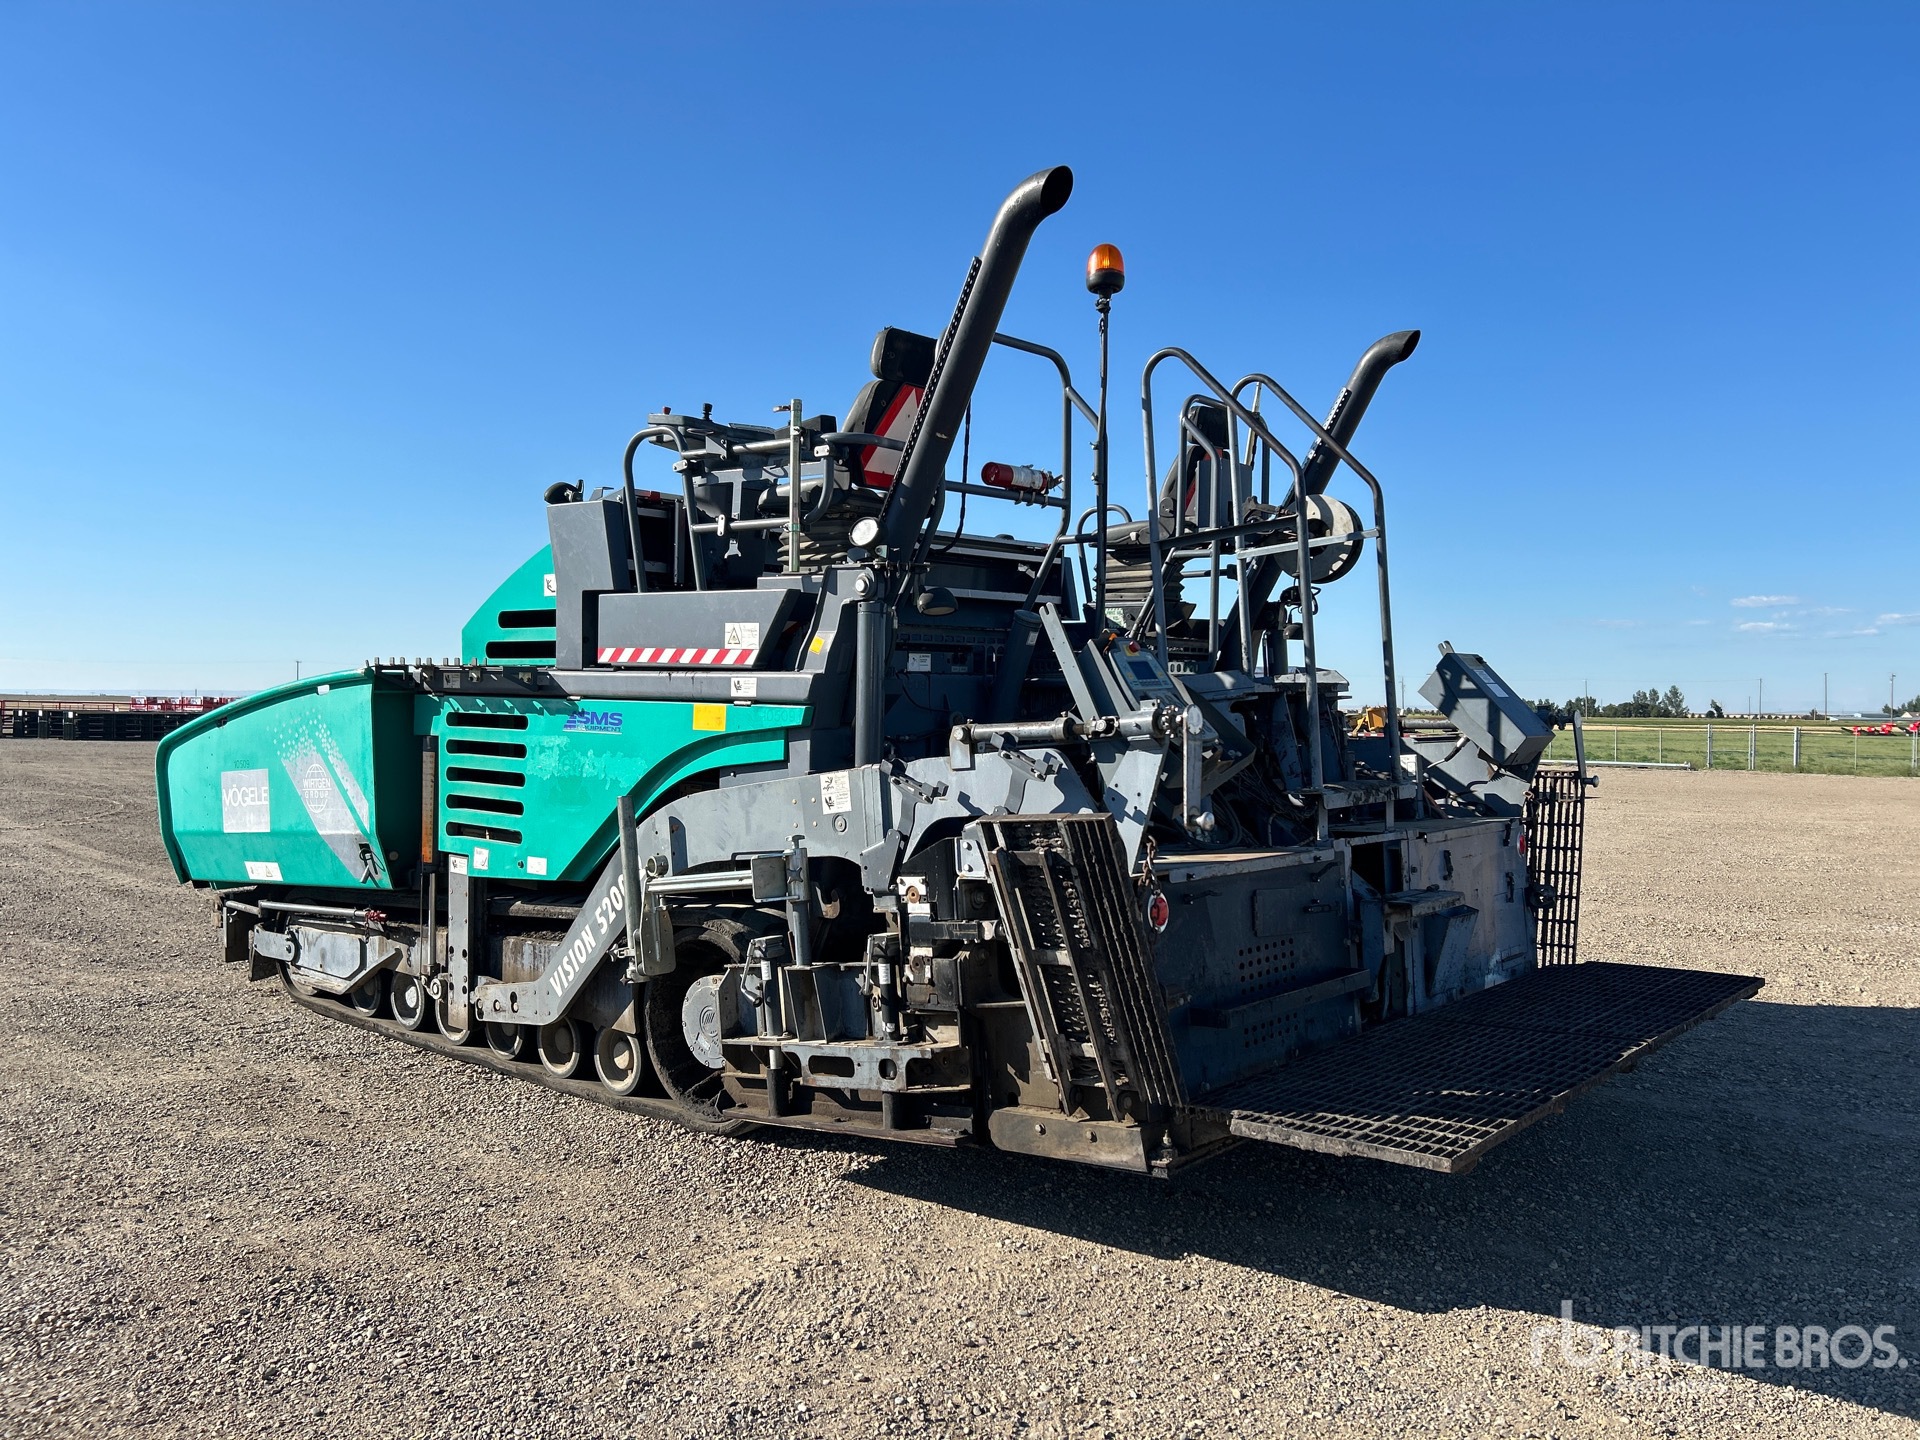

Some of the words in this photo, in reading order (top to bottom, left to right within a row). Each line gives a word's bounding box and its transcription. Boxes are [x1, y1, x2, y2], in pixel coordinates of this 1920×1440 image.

[577, 710, 623, 727] SMS
[302, 777, 331, 789] WIRTGEN
[222, 784, 269, 807] VÖGELE
[304, 790, 329, 799] GROUP
[549, 924, 597, 998] VISION
